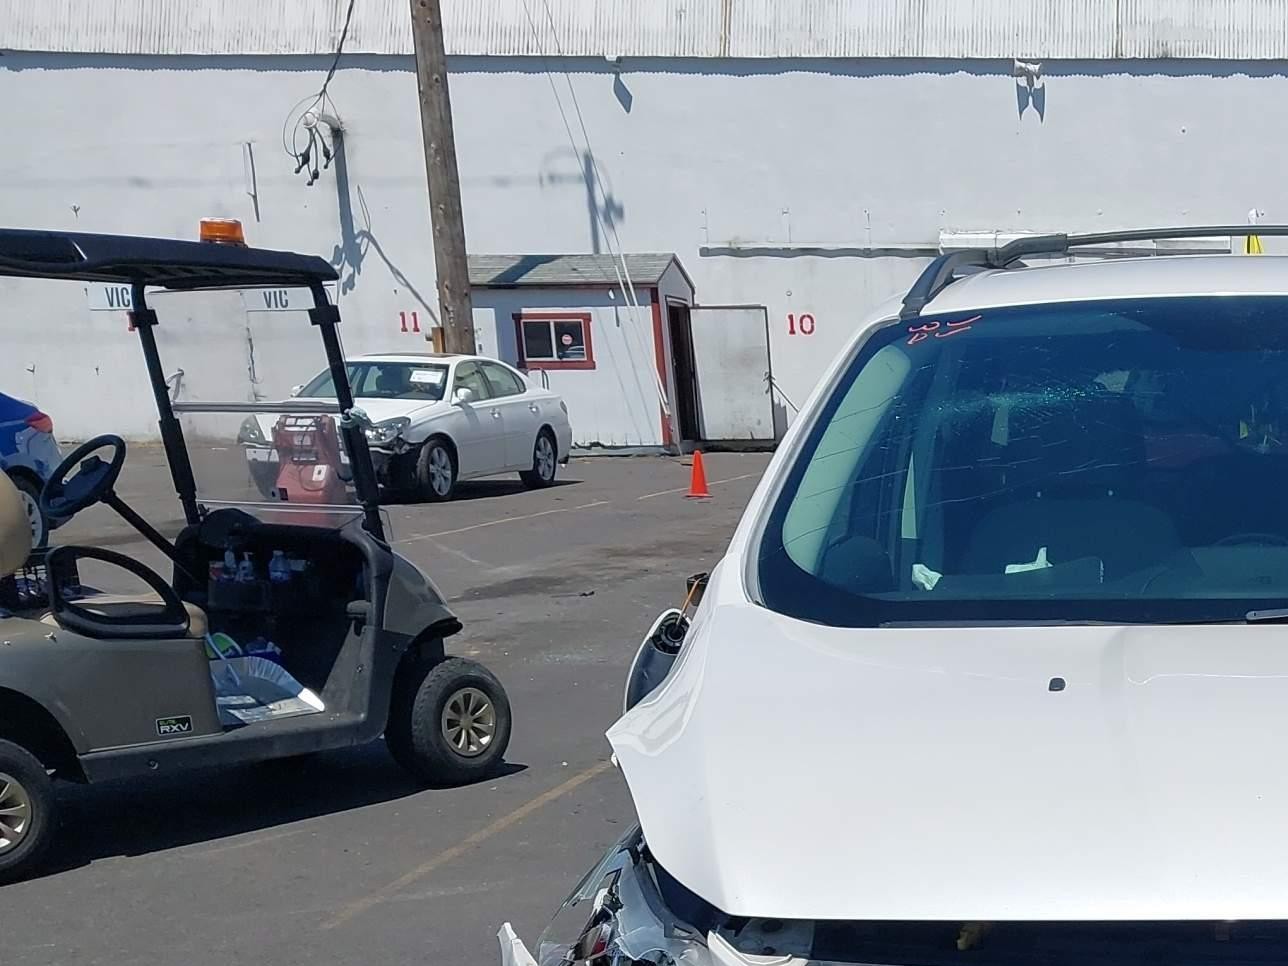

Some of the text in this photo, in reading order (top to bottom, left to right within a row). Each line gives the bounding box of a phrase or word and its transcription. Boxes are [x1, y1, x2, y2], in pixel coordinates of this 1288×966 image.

[400, 311, 420, 332] 11
[788, 314, 815, 335] 10
[160, 722, 189, 734] RXV
